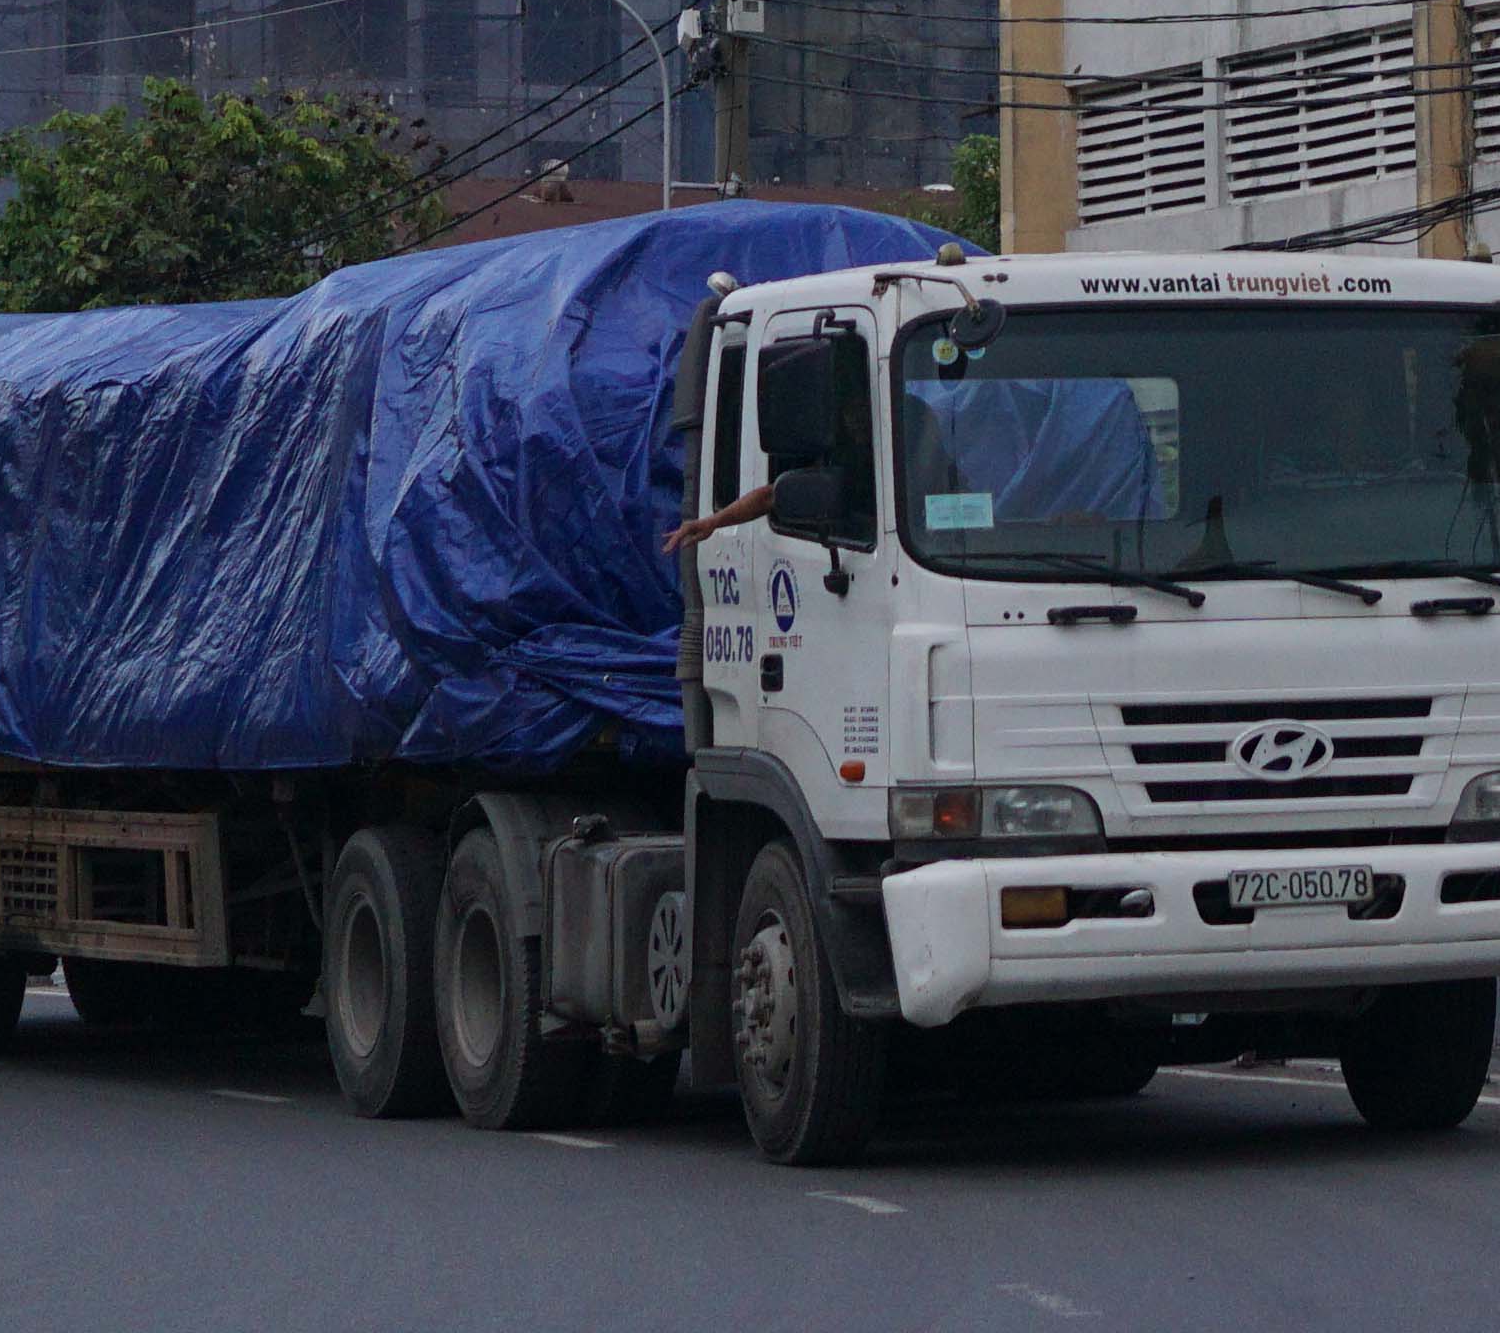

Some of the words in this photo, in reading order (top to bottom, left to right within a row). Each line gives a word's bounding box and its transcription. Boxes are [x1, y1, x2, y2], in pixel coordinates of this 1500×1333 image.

[1081, 272, 1220, 294] www.vantai
[1226, 272, 1331, 297] trungviet
[1337, 276, 1392, 294] .com
[709, 567, 740, 605] 72C
[706, 625, 754, 663] 050.78
[1235, 869, 1368, 903] 72C-050.78
